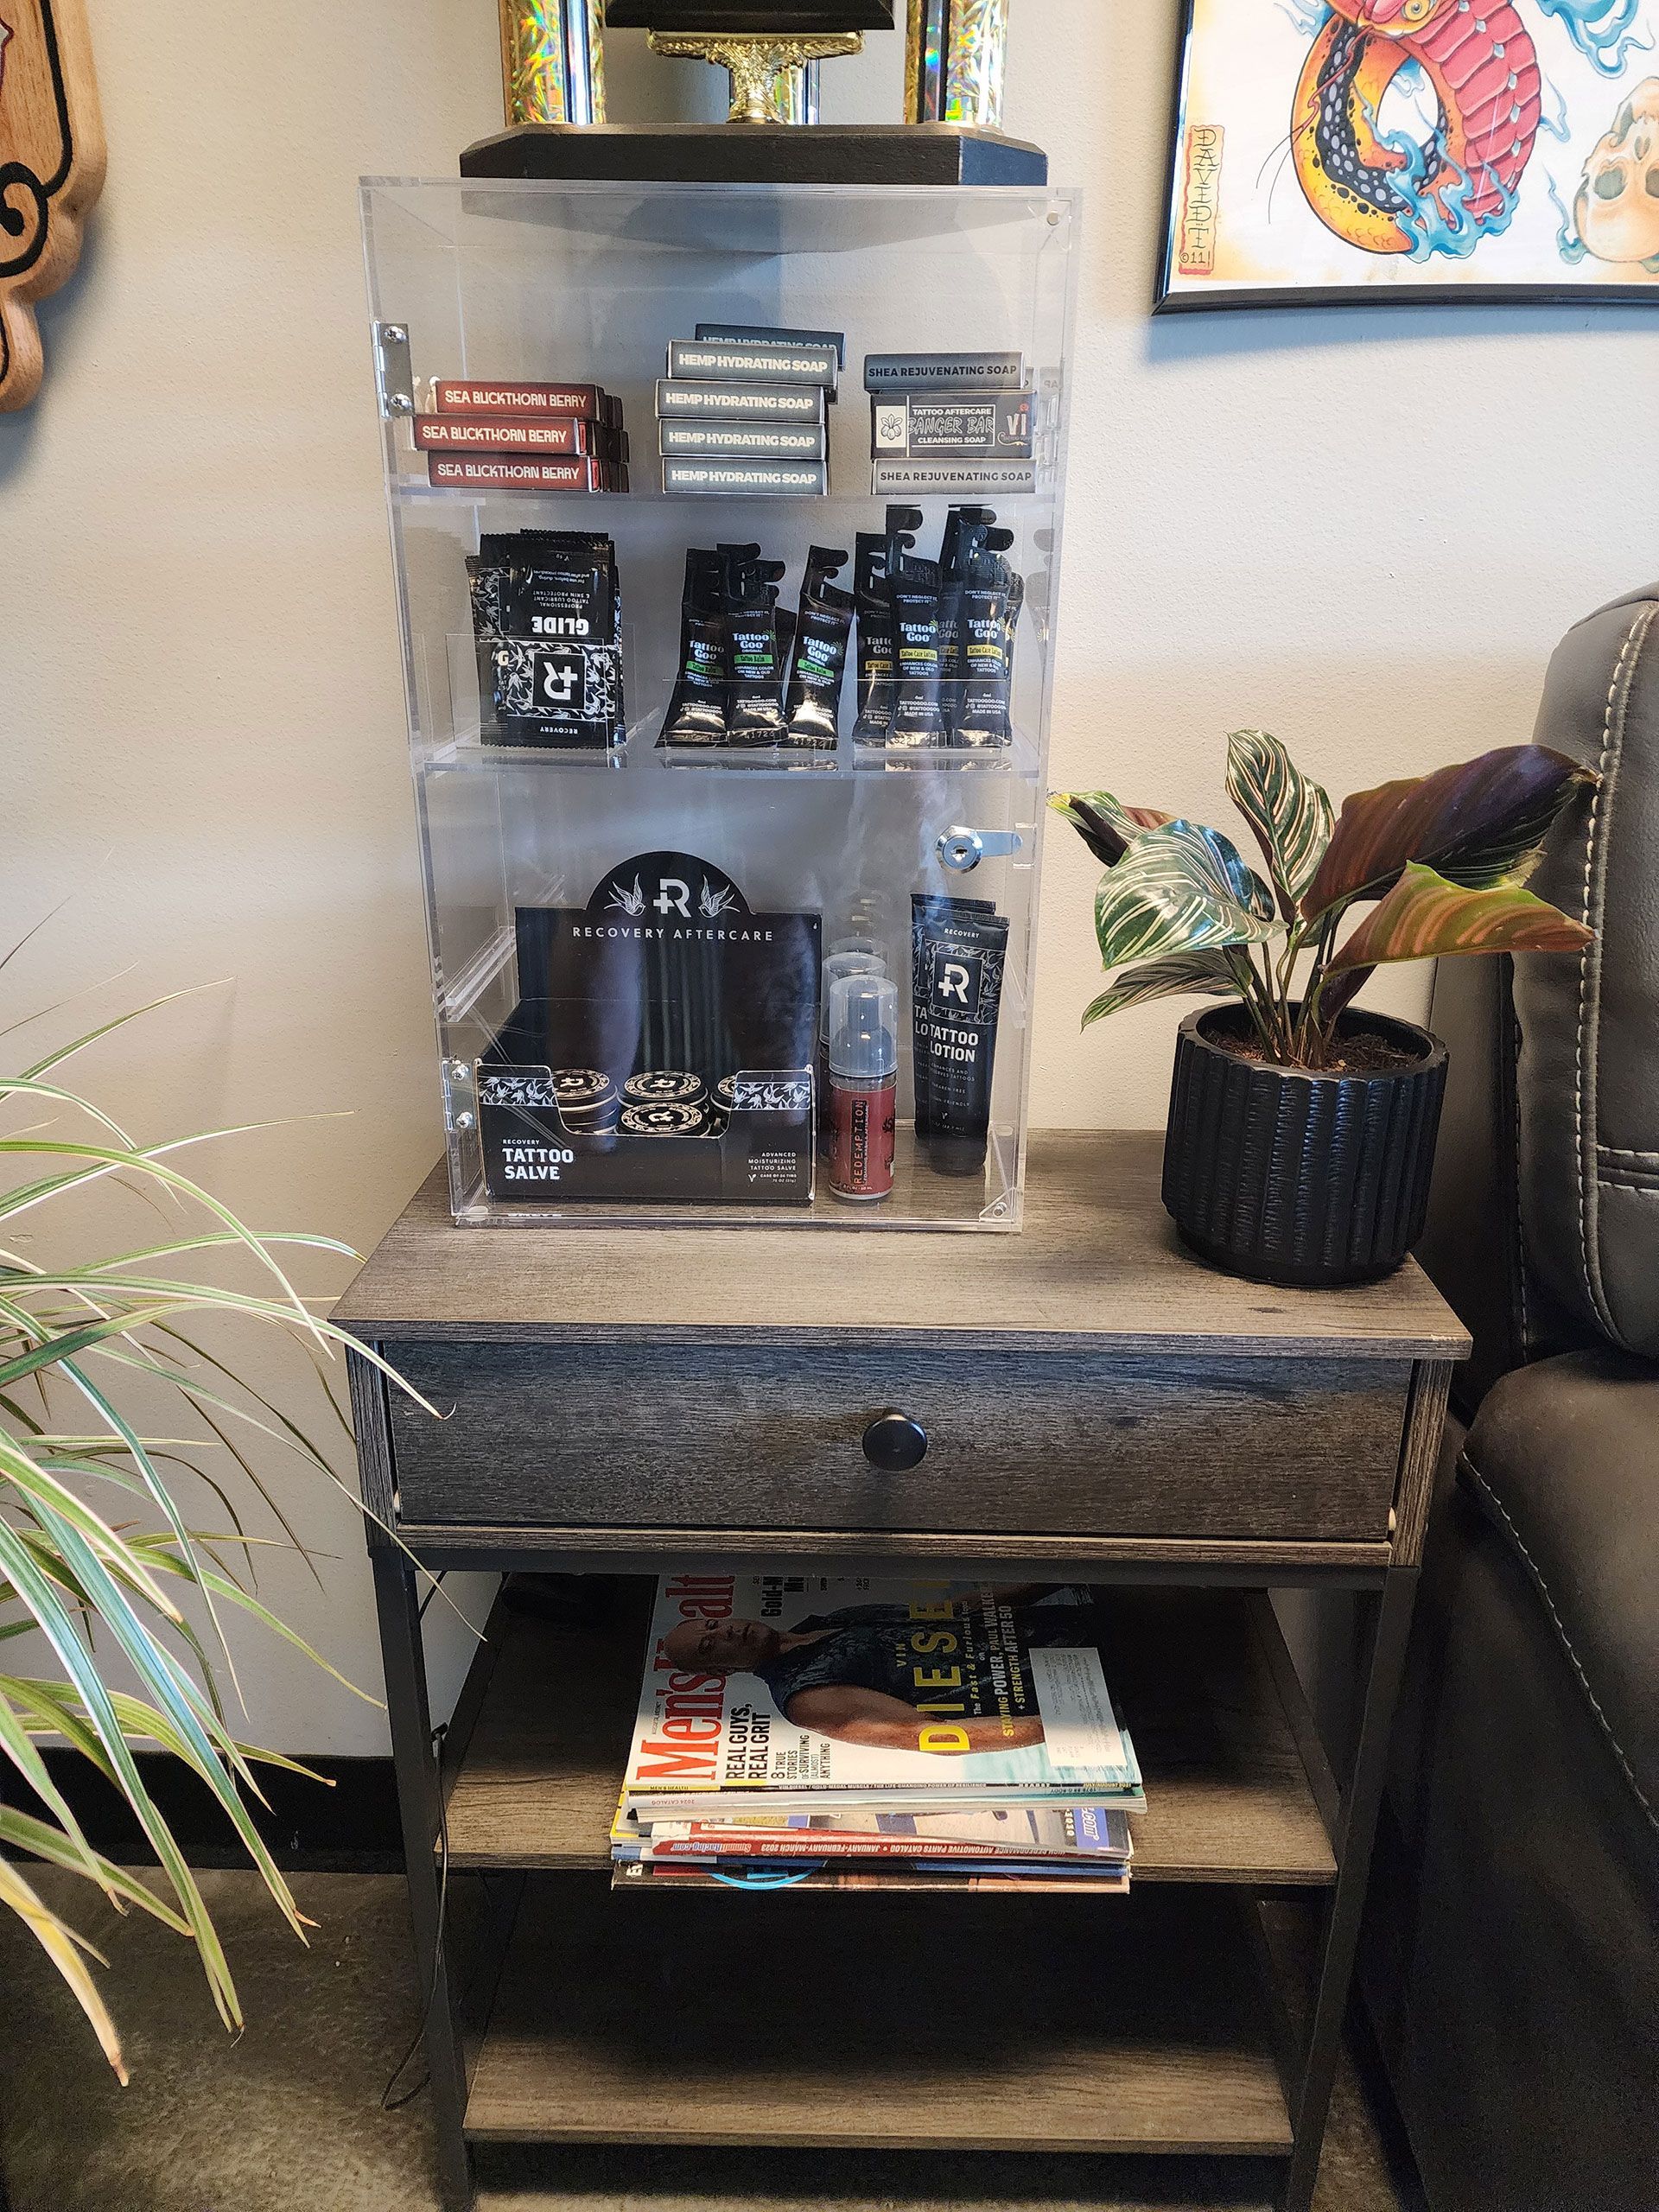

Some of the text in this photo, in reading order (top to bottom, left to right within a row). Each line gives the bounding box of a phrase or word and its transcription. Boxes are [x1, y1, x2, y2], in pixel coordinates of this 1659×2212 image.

[679, 353, 828, 372] HEMP HYDRATING SOAP
[868, 365, 1017, 378] SHEA REJUVENATING SOAP
[445, 390, 588, 409] SEA BUCKTHORN BERRY
[665, 392, 814, 410] HEMP HYDRATING SOAP
[422, 425, 568, 443] SEA BUCKTHORN BERRY
[907, 416, 995, 435] BANGER BAR
[669, 432, 816, 448] HEMP HYDRATING SOAP
[437, 463, 580, 480] SEA BUCKTHORN BERRY
[671, 470, 817, 485] HEMP HYDRATING SOAP
[880, 472, 1032, 481] SHEA REJUVENATING SOAP
[531, 616, 589, 636] GLIDE
[899, 622, 936, 633] Tattoo
[967, 619, 1001, 632] Tattoo
[974, 628, 999, 639] Goo
[732, 632, 769, 641] Tattoo
[740, 640, 764, 649] Goo
[906, 632, 931, 642] Goo
[689, 640, 724, 653] Tattoo
[803, 636, 837, 655] Tattoo
[807, 645, 830, 662] Goo
[694, 649, 717, 660] Goo
[539, 726, 578, 734] RECOVERY
[572, 927, 773, 941] RECOVERY AFTERCARE
[944, 927, 980, 938] RECOVERY
[930, 1024, 979, 1046] TATTOO
[930, 1039, 976, 1063] LOTION
[854, 1101, 864, 1184] REDEMPTION
[502, 1147, 575, 1164] TATTOO
[504, 1166, 561, 1180] SALVE
[998, 1605, 1013, 1620] 50
[1001, 1621, 1019, 1654] AFTER
[896, 1643, 907, 1668] VIN
[980, 1590, 1016, 1738] STAYING POWER, PAUL WALKE
[963, 1618, 982, 1715] The Fast & Furious
[1007, 1655, 1027, 1704] STRENGTH
[634, 1671, 728, 1782] Men's
[726, 1703, 753, 1780] REAL GUYS,
[747, 1712, 771, 1780] REAL GRIT
[799, 1734, 810, 1774] SURVIVING
[820, 1743, 830, 1780] ANYTHING
[771, 1751, 785, 1780] 8 TRUE
[787, 1751, 798, 1780] STORIES
[810, 1753, 820, 1780] (ALMOST)
[671, 1841, 752, 1854] SummitRacing.com
[760, 1843, 779, 1853] 2023
[890, 1844, 994, 1854] AUTOMOTIVE PARTS CATALOG
